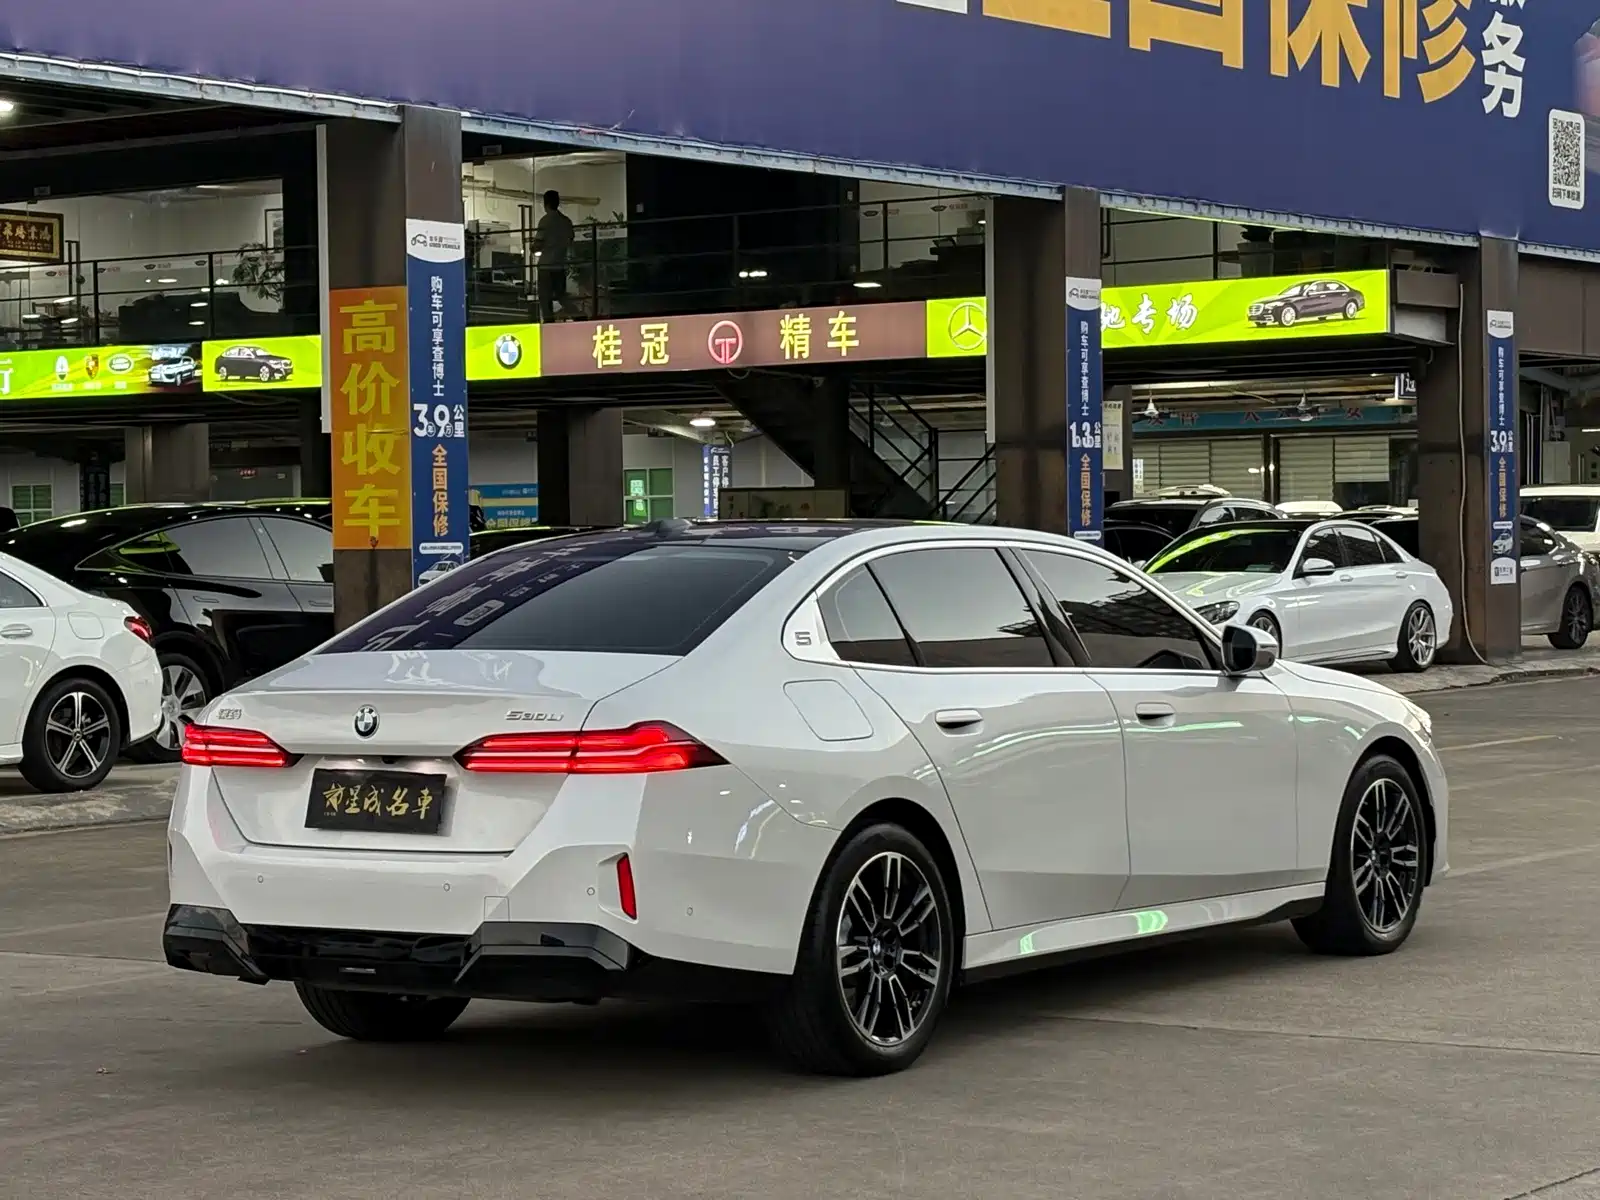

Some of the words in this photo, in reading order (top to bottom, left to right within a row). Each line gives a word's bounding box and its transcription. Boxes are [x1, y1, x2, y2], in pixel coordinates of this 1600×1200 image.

[1482, 0, 1526, 118] 务
[430, 275, 445, 397] 购车可享查博士
[592, 322, 670, 369] 桂冠
[779, 310, 860, 360] 精车
[340, 299, 400, 538] 高价收车
[431, 443, 449, 537] 全国保修
[1081, 453, 1091, 527] 全国保修
[795, 631, 812, 646] 5
